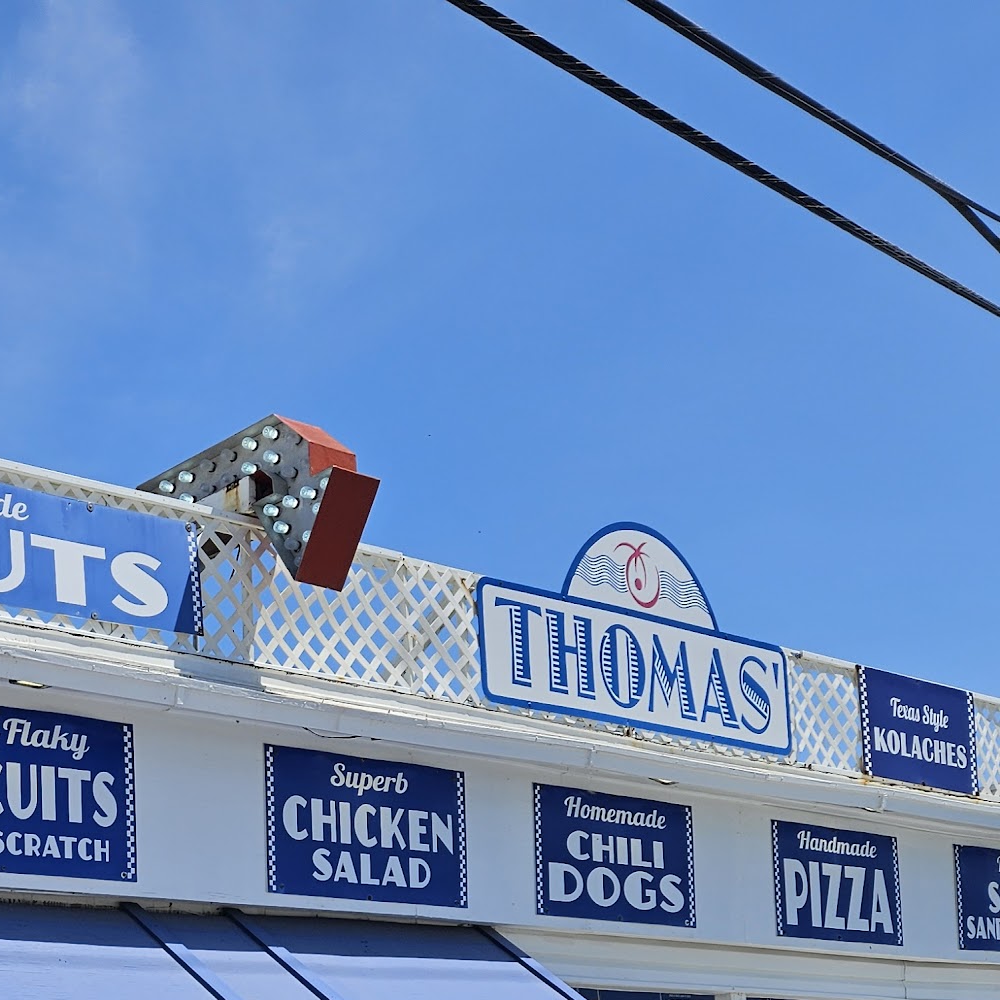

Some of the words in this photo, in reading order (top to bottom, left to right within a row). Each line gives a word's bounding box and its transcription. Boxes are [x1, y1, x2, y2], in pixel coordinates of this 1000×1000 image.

[494, 596, 779, 735] THOMAS'
[889, 697, 920, 722] Texas
[922, 704, 949, 733] Style
[2, 718, 91, 761] Flaky
[873, 726, 968, 769] KOLACHES
[330, 762, 409, 797] Superb
[282, 794, 454, 856] CHICKEN
[564, 796, 668, 830] Homemade
[566, 830, 665, 870] CHILI
[797, 830, 878, 859] Handmade
[312, 847, 432, 889] SALAD
[548, 861, 685, 913] DOGS
[783, 857, 894, 934] PIZZA
